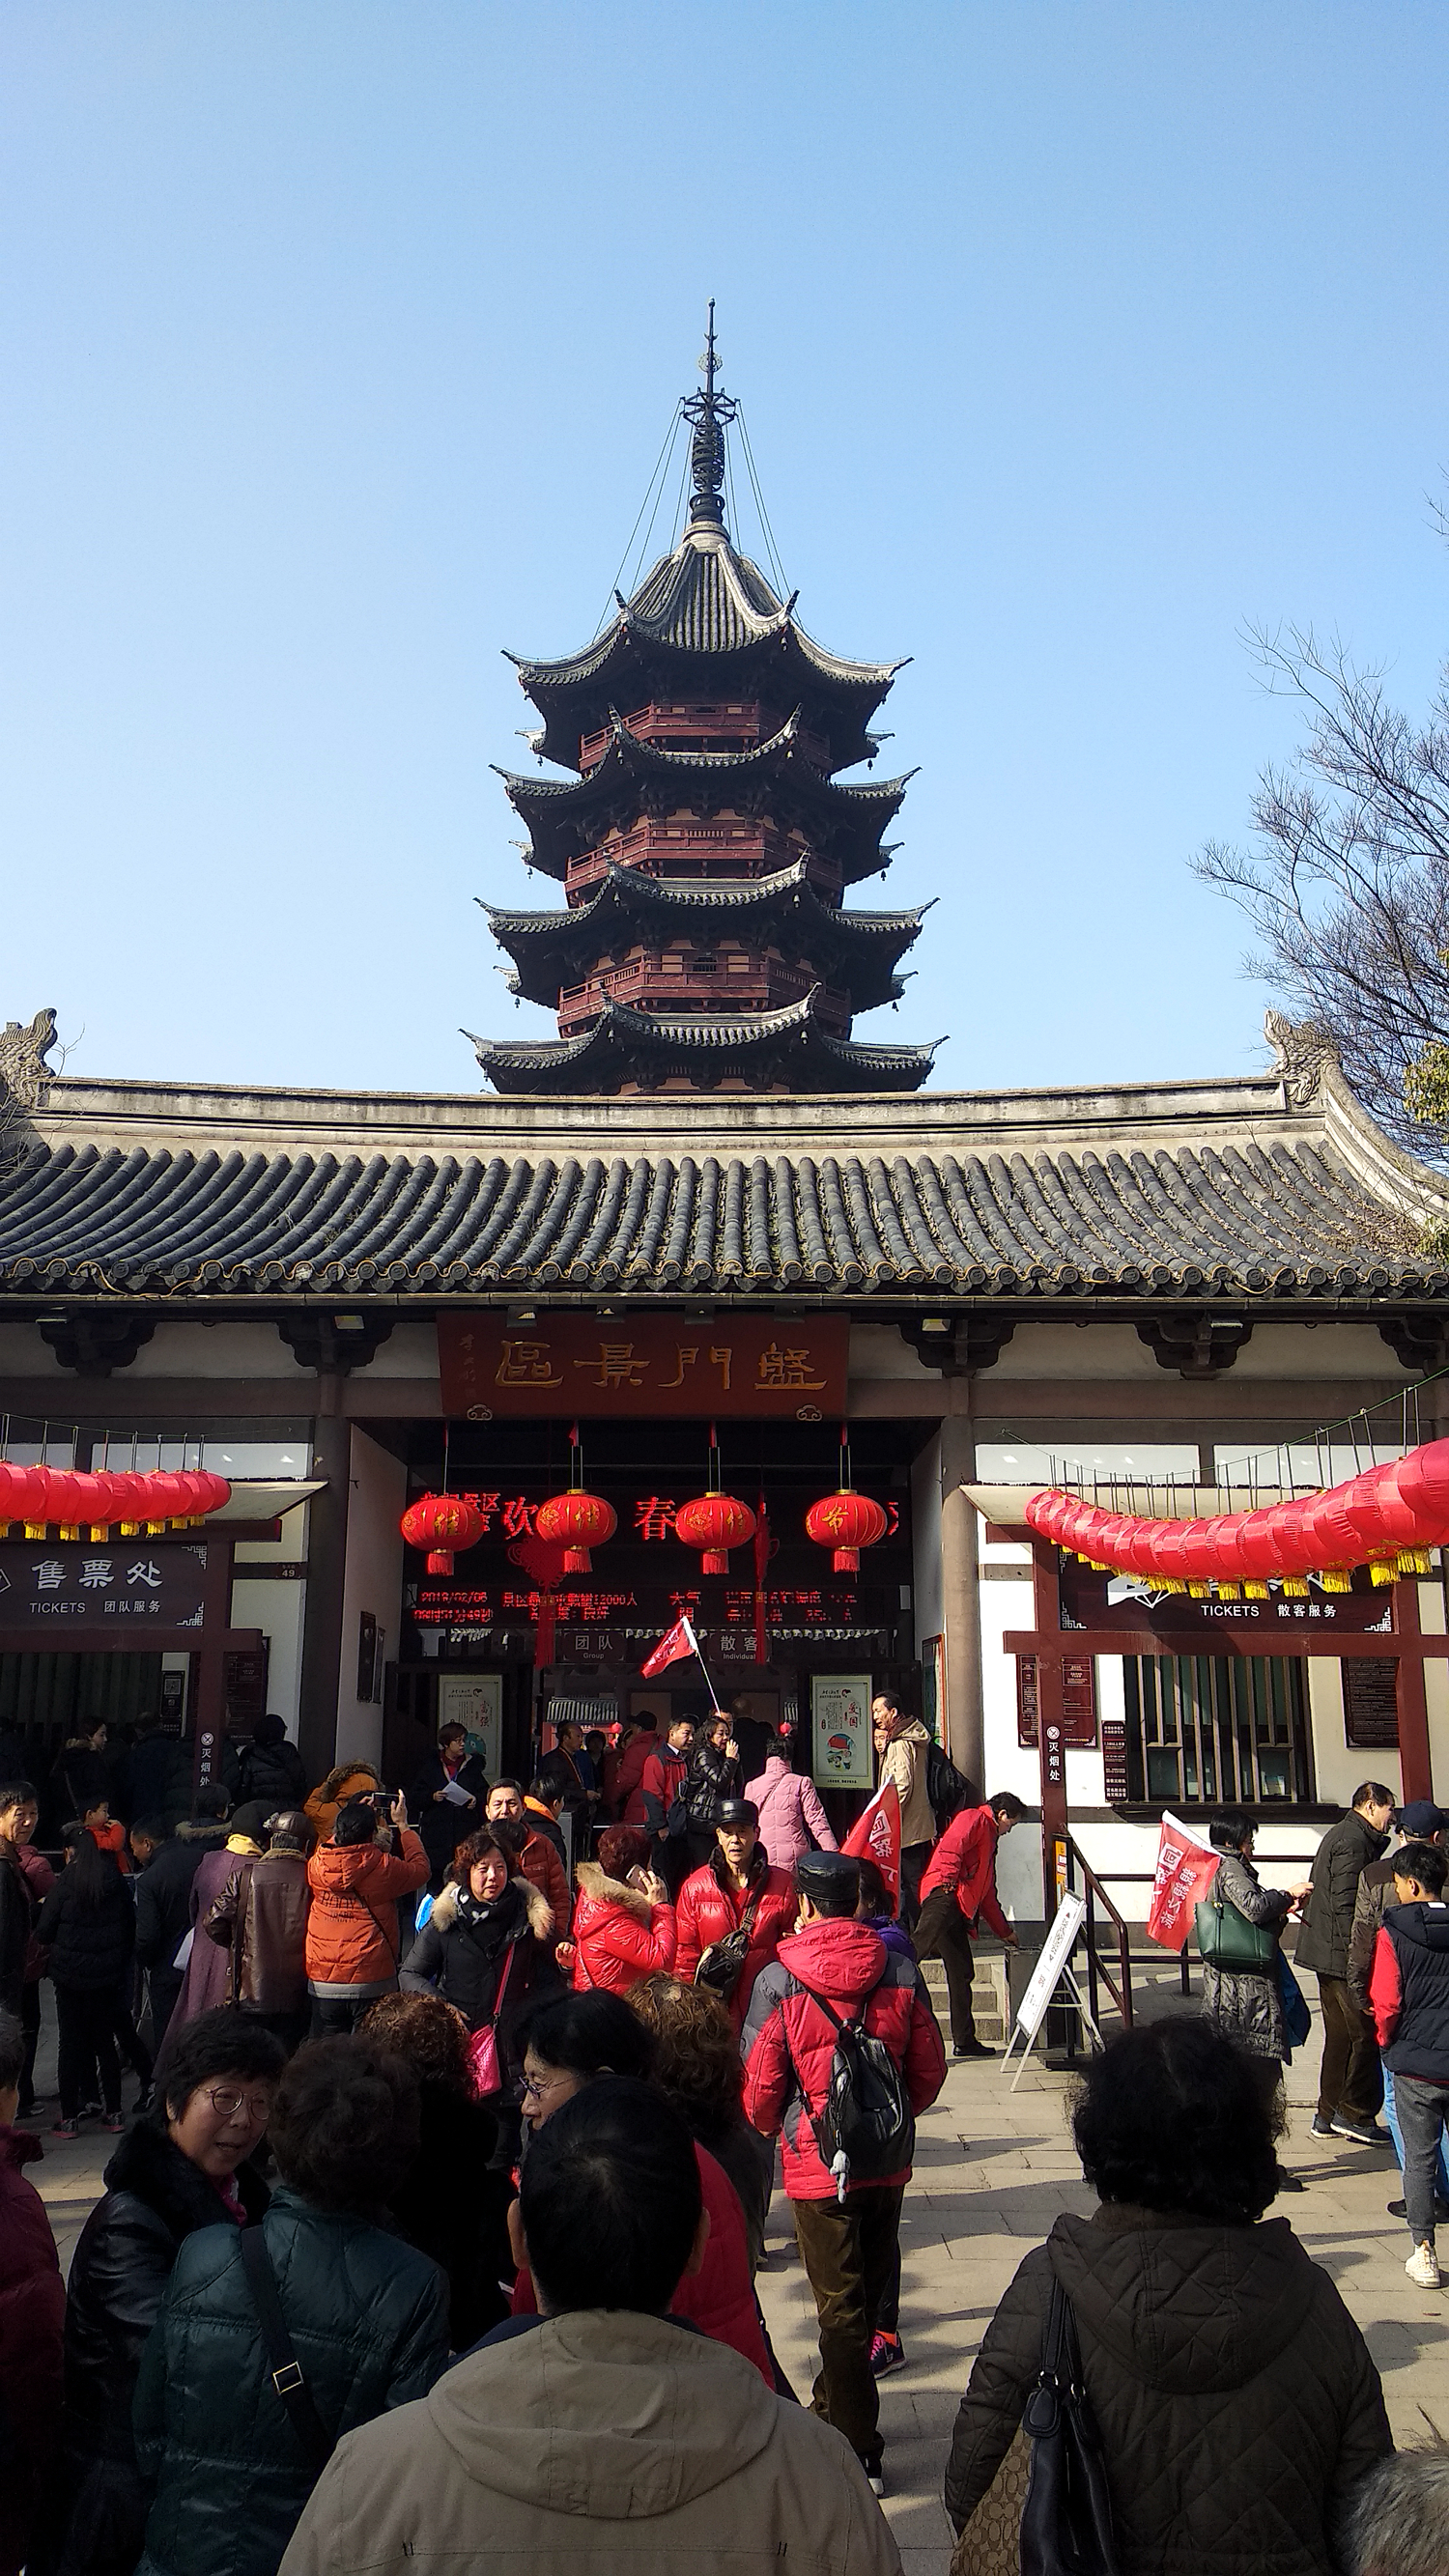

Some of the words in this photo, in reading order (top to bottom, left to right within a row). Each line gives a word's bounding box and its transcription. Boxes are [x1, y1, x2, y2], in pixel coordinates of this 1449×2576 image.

[32, 1559, 163, 1590] 售票处
[282, 1569, 296, 1578] 49
[30, 1602, 86, 1614] TICKETS
[103, 1599, 161, 1614] 团队服务
[1201, 1604, 1260, 1617] TICKETS
[1277, 1603, 1337, 1618] 散客服务
[575, 1634, 613, 1651] 团队
[720, 1634, 758, 1653] 散客
[582, 1652, 605, 1660] Group
[199, 1747, 212, 1787] 灭烟处
[1048, 1741, 1061, 1781] 灭烟处
